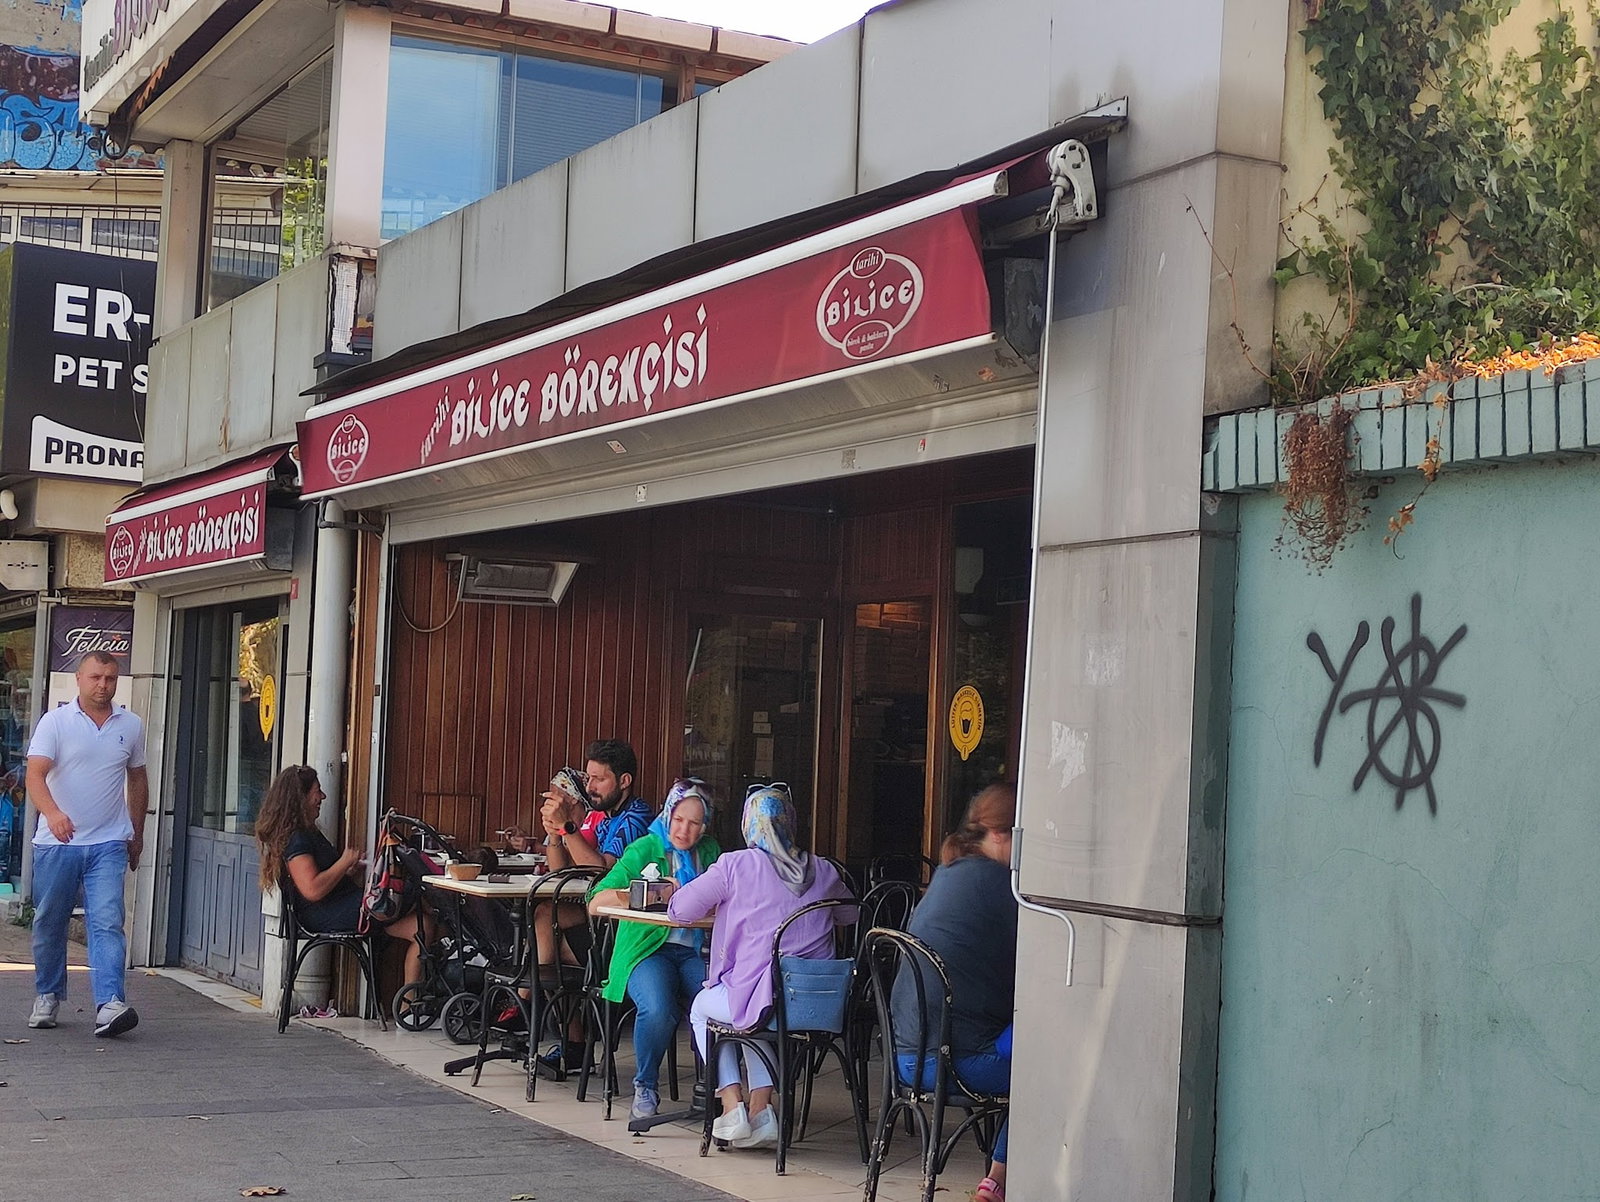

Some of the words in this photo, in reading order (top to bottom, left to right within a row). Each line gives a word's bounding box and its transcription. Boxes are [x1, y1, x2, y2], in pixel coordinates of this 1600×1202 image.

[855, 251, 880, 271] tarihi
[826, 279, 913, 328] BİLİCE
[53, 353, 123, 390] PET
[449, 369, 531, 448] BİLİCE
[538, 303, 708, 425] BÖREKÇİSİ
[186, 490, 260, 557] BÖREKÇİSİ
[61, 625, 130, 657] Felicia
